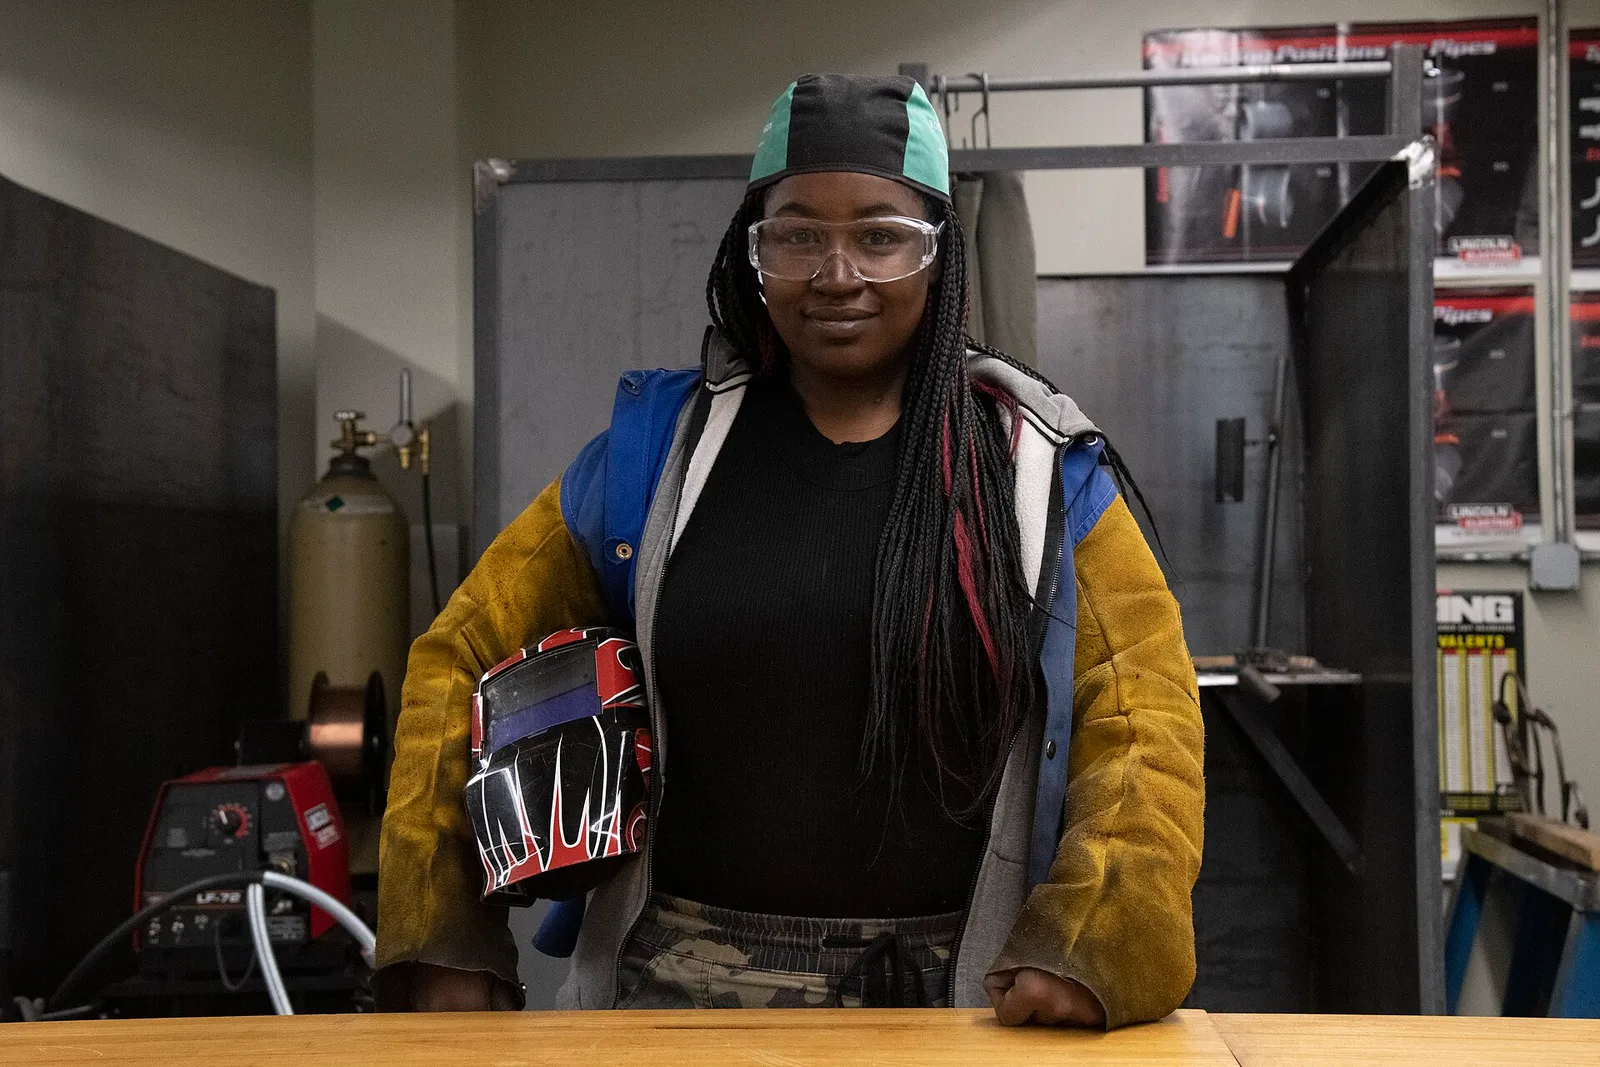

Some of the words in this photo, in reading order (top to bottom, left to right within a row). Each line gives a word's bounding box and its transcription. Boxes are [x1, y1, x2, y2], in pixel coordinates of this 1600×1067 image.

[1275, 45, 1387, 62] Positons
[1429, 39, 1496, 58] Pipes
[1451, 237, 1508, 252] LINCOLN
[1451, 505, 1508, 519] LINCOLN
[1436, 595, 1515, 624] ING
[1437, 634, 1506, 648] VALENTS
